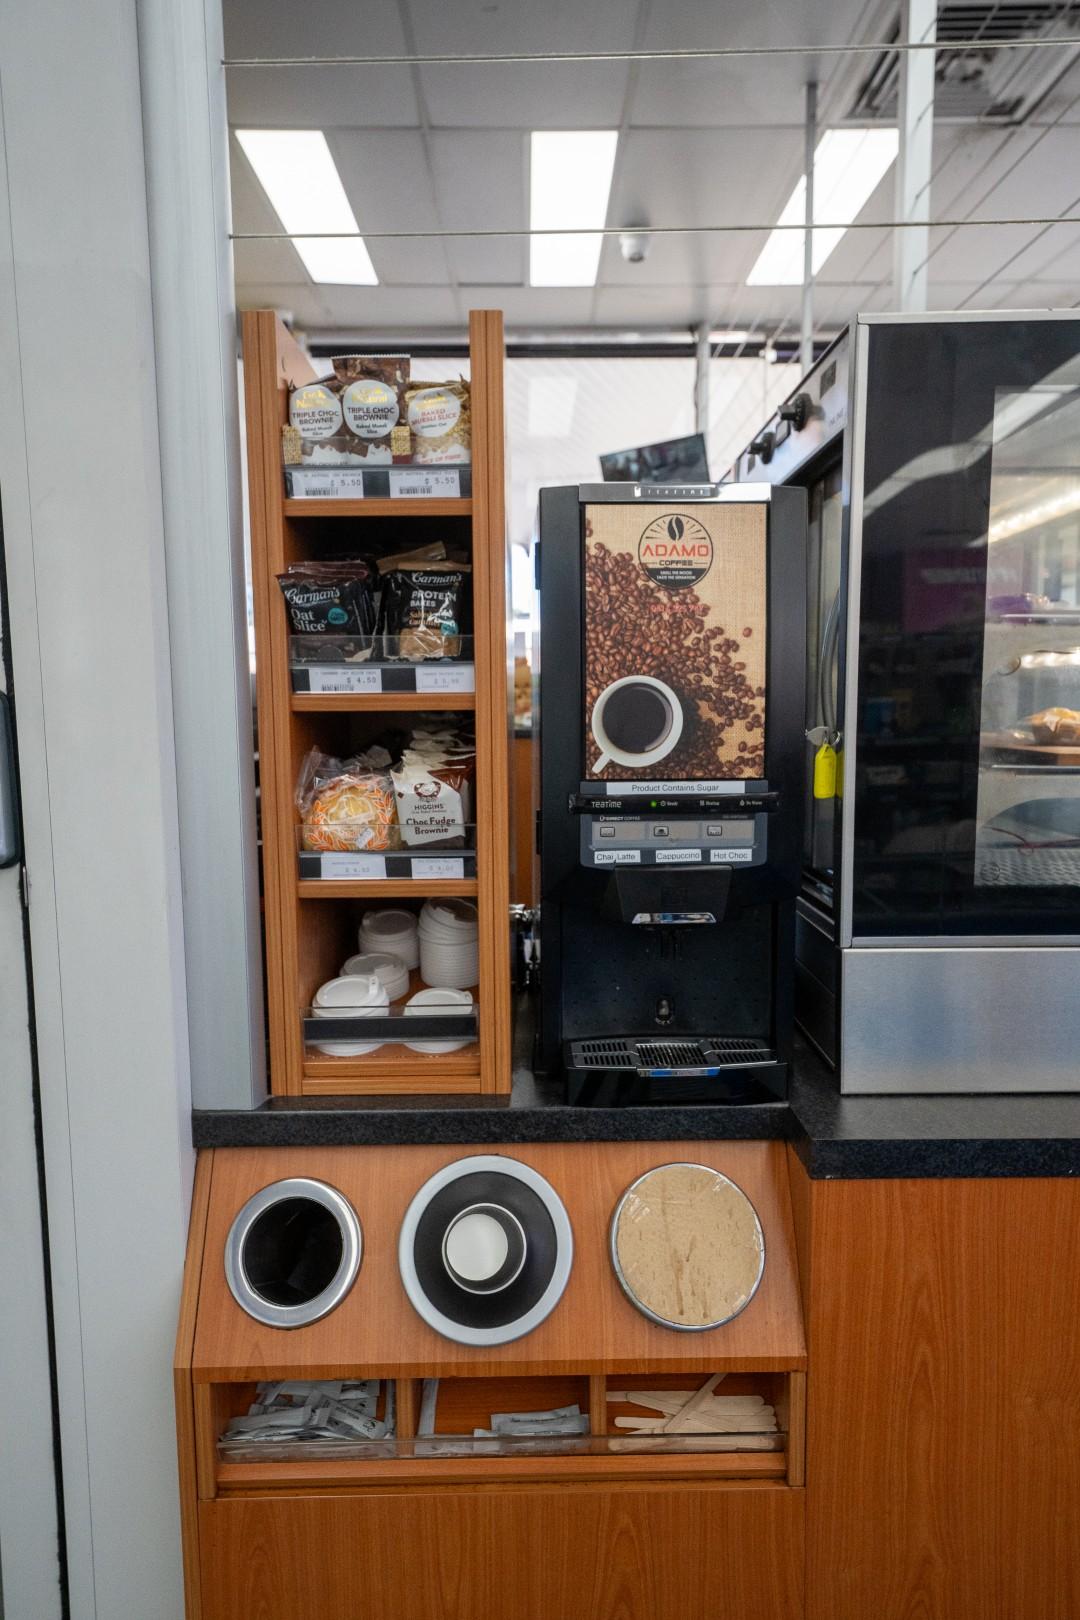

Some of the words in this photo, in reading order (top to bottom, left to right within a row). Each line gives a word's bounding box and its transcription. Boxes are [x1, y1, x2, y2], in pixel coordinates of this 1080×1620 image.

[292, 411, 316, 419] TRIPLE
[437, 412, 457, 422] SLICE
[299, 417, 334, 425] BROWNIE
[340, 479, 361, 487] 5.50
[434, 477, 456, 485] 5.50
[642, 543, 709, 557] ADAMO
[411, 571, 462, 583] Carman's
[286, 587, 340, 604] Carman's
[412, 590, 457, 602] PROTEIN
[291, 608, 315, 621] Oat
[293, 619, 326, 632] Slice
[631, 784, 660, 792] Product
[662, 783, 695, 792] Contains
[697, 783, 719, 793] Sugar
[406, 817, 429, 826] Choc
[430, 816, 456, 827] Fudge
[414, 827, 449, 835] Brownie
[596, 853, 614, 861] Chai
[617, 853, 636, 861] Latte
[656, 852, 700, 862] Cappuccino
[728, 851, 748, 859] Choc
